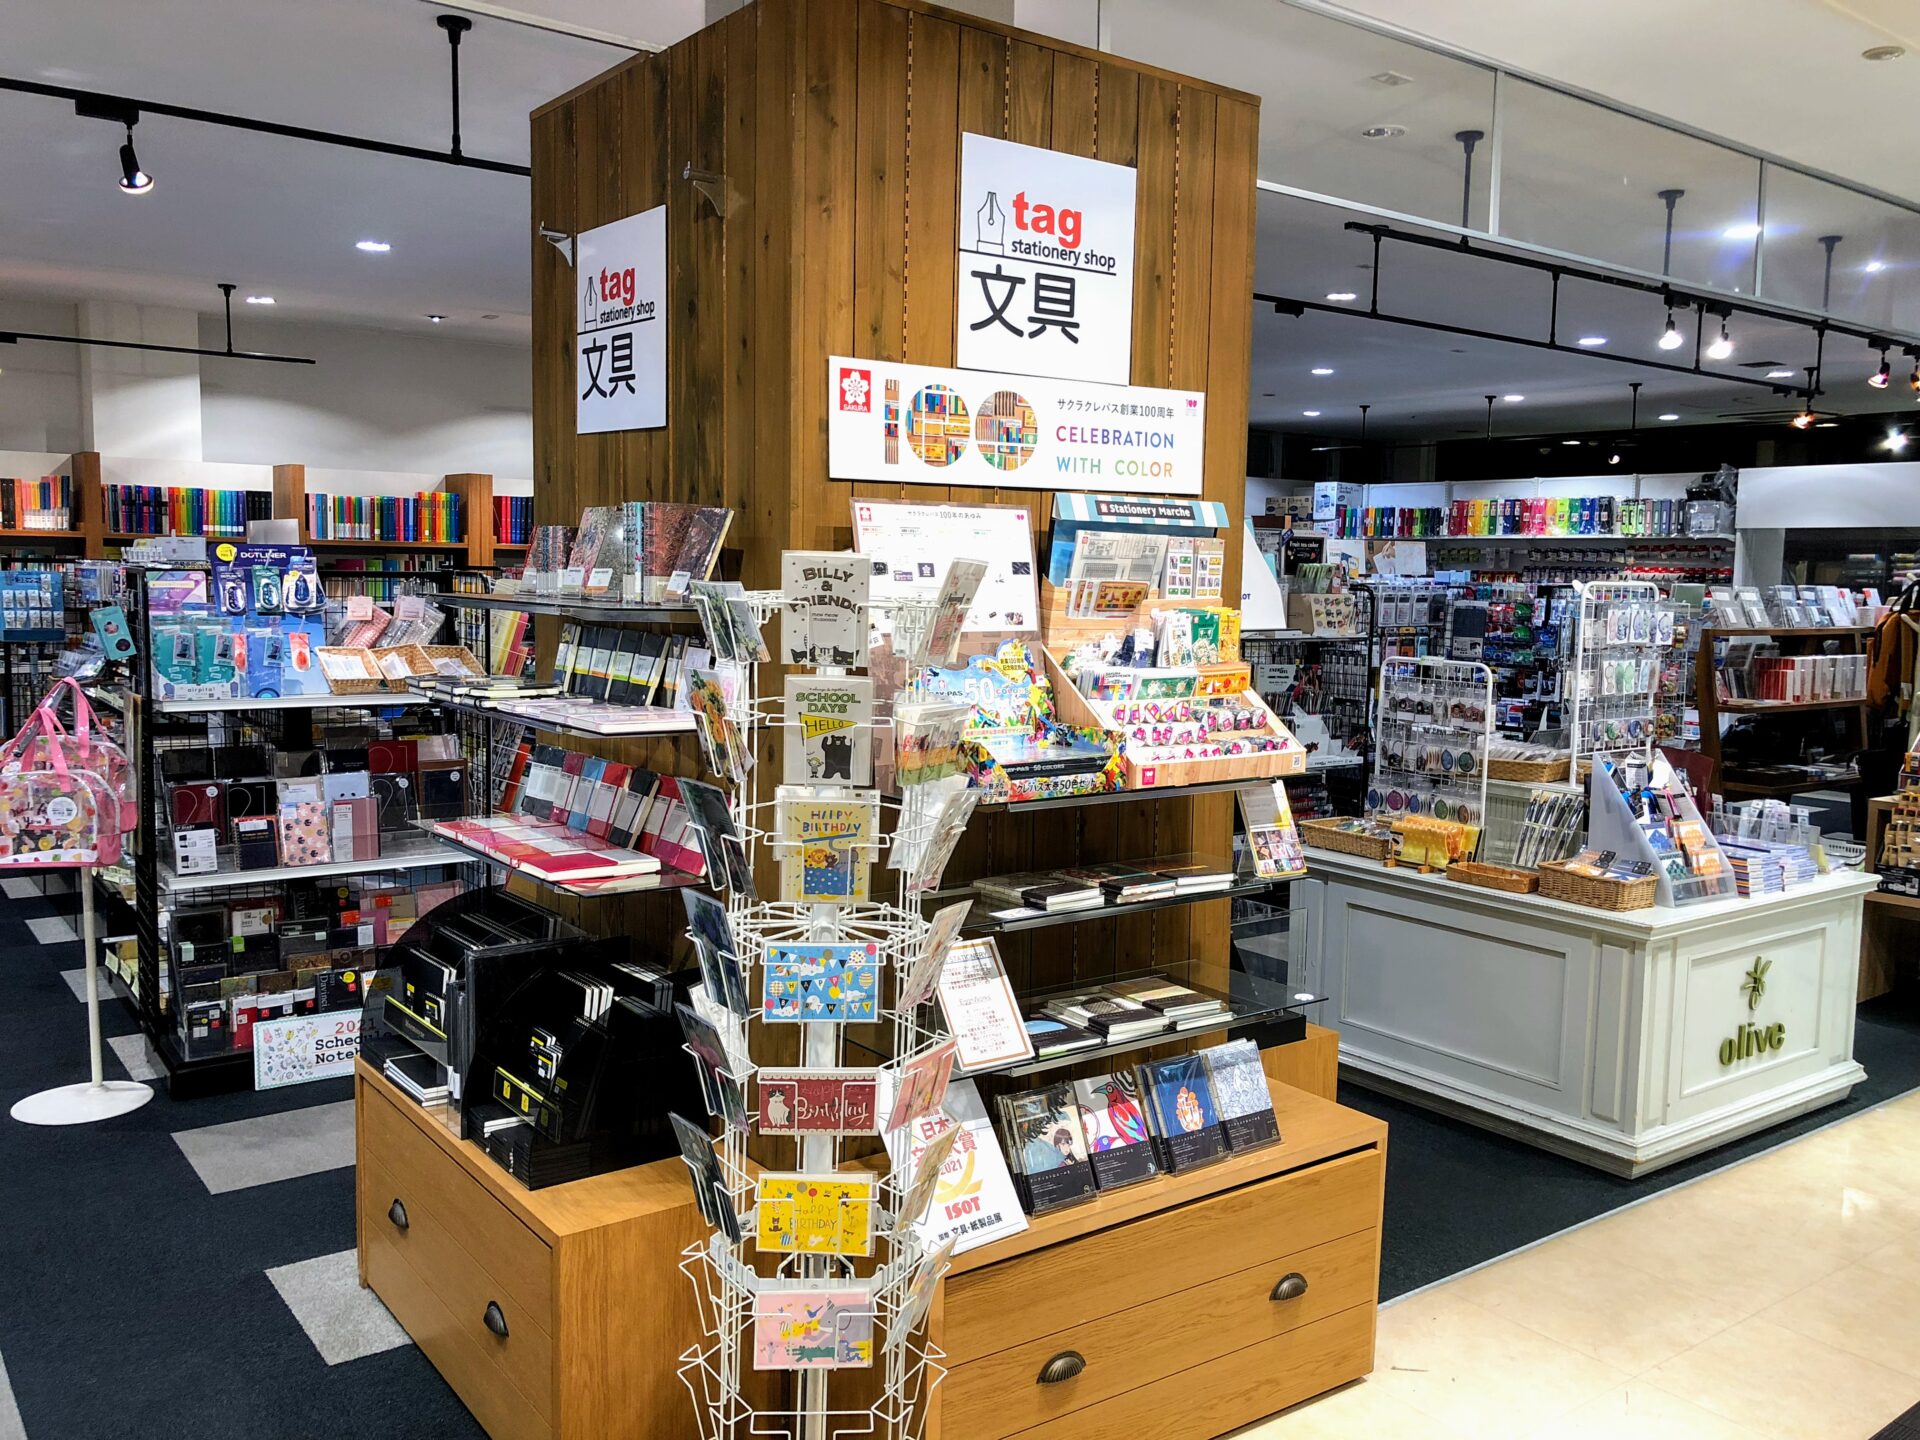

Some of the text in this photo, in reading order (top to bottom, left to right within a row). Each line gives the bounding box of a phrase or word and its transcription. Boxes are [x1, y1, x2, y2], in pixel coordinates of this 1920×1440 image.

[1012, 191, 1082, 249] tag
[1011, 239, 1116, 271] stationery shop
[600, 266, 636, 307] tag
[599, 299, 655, 325] stationery shop
[970, 263, 1080, 344] 文具
[582, 332, 636, 401] 文具
[843, 403, 868, 412] SAKURA
[1057, 398, 1175, 419] サクラクレパス創業100周年
[1056, 425, 1174, 449] CELEBRATION
[1056, 456, 1173, 478] WITH COLOR
[1109, 503, 1191, 518] Stationery Marche
[240, 551, 287, 559] DOTLINER
[802, 567, 854, 583] BILLY
[821, 580, 832, 591] &
[789, 594, 863, 615] FRIENDS
[795, 692, 861, 704] SCHOOL
[964, 677, 995, 704] 50
[807, 703, 848, 714] DAYS
[805, 719, 844, 733] HELLO
[335, 1017, 377, 1035] 2021
[1719, 1022, 1786, 1066] olive
[920, 1116, 952, 1141] 日本
[944, 1196, 982, 1221] ISOT
[789, 1216, 838, 1231] BIRTHDAY
